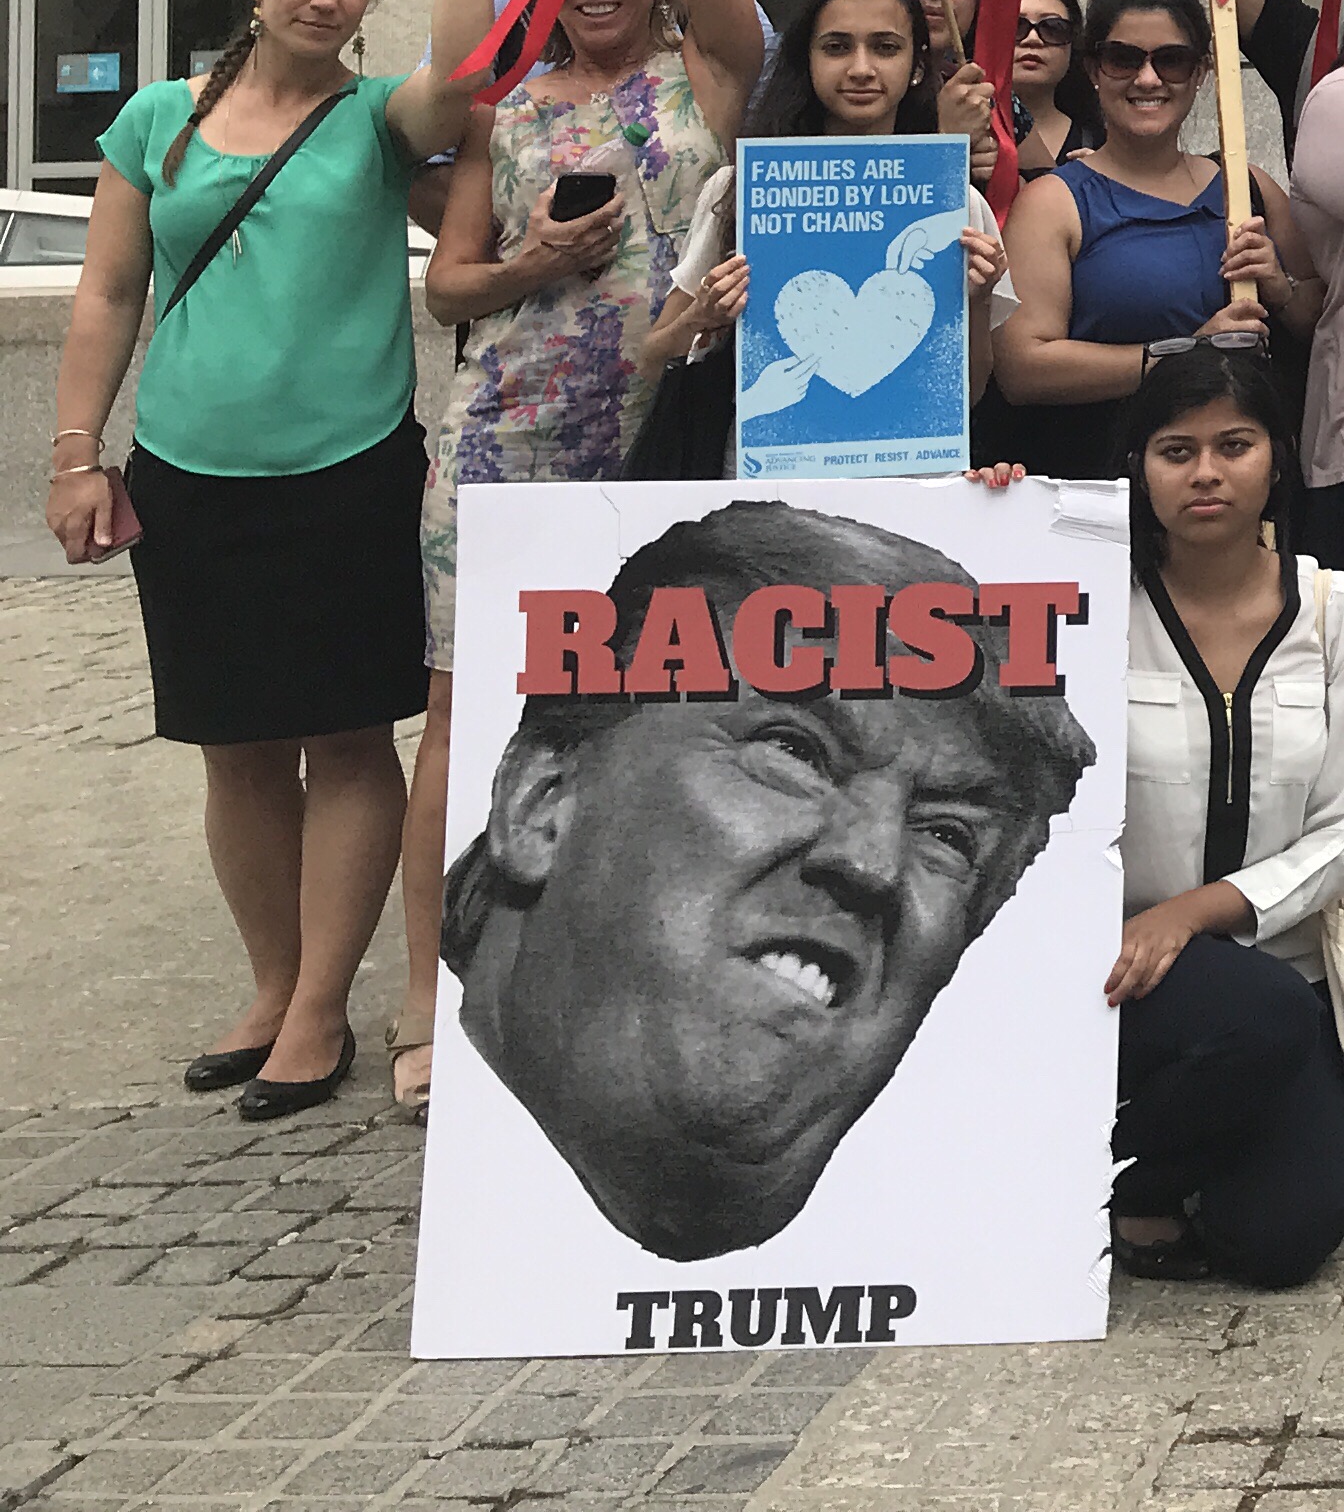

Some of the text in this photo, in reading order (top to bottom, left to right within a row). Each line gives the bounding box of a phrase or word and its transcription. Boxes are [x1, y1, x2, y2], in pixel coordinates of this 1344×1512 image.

[751, 159, 905, 182] FAMILIES ARE
[751, 184, 935, 208] BONDED BY LOVE
[750, 210, 885, 235] NOT CHAINS
[515, 581, 1090, 704] RACIST
[616, 1283, 919, 1351] TRUMP
